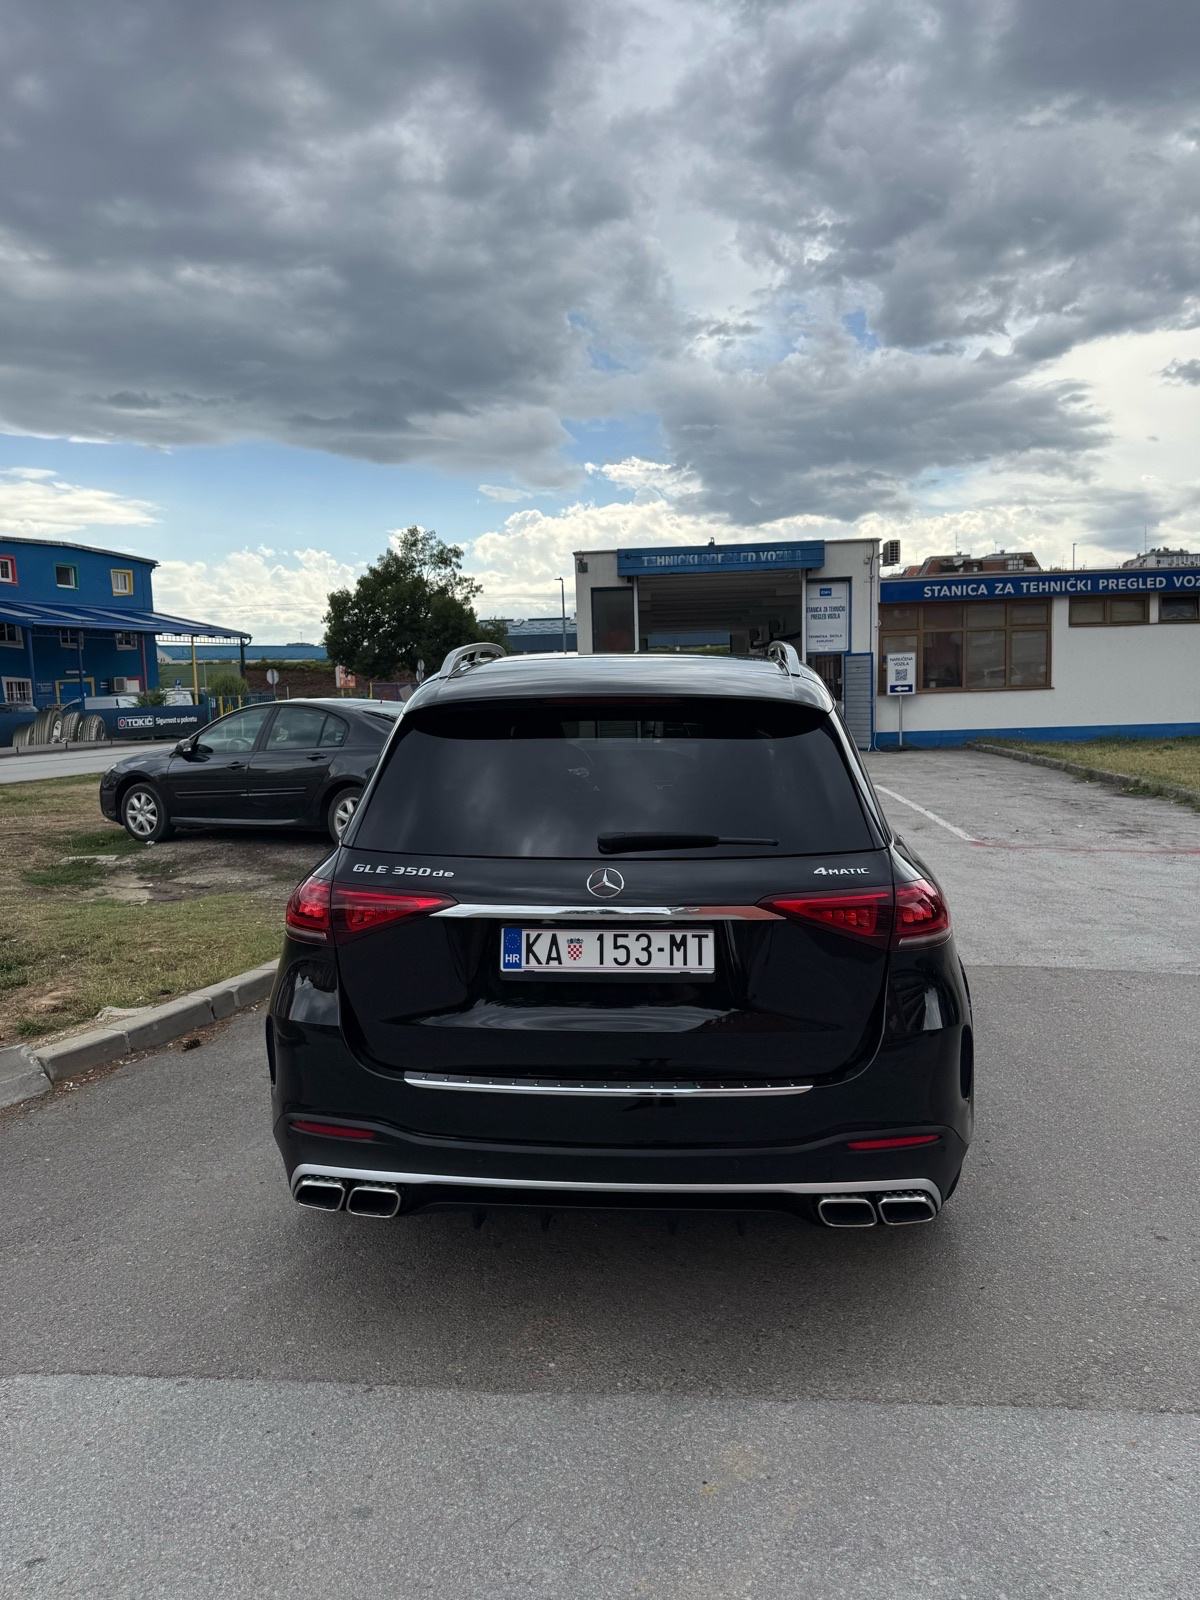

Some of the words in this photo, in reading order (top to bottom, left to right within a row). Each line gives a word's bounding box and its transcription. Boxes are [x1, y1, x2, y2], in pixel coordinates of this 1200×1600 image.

[923, 583, 988, 598] STANICA
[994, 582, 1014, 595] ZA
[1021, 577, 1092, 593] TEHNIČKI
[1099, 576, 1167, 591] PREGLED
[352, 863, 390, 874] GLE
[813, 867, 870, 876] 4MATIC
[525, 932, 563, 966] KA
[596, 933, 709, 966] 153-MT
[505, 953, 520, 963] HR
